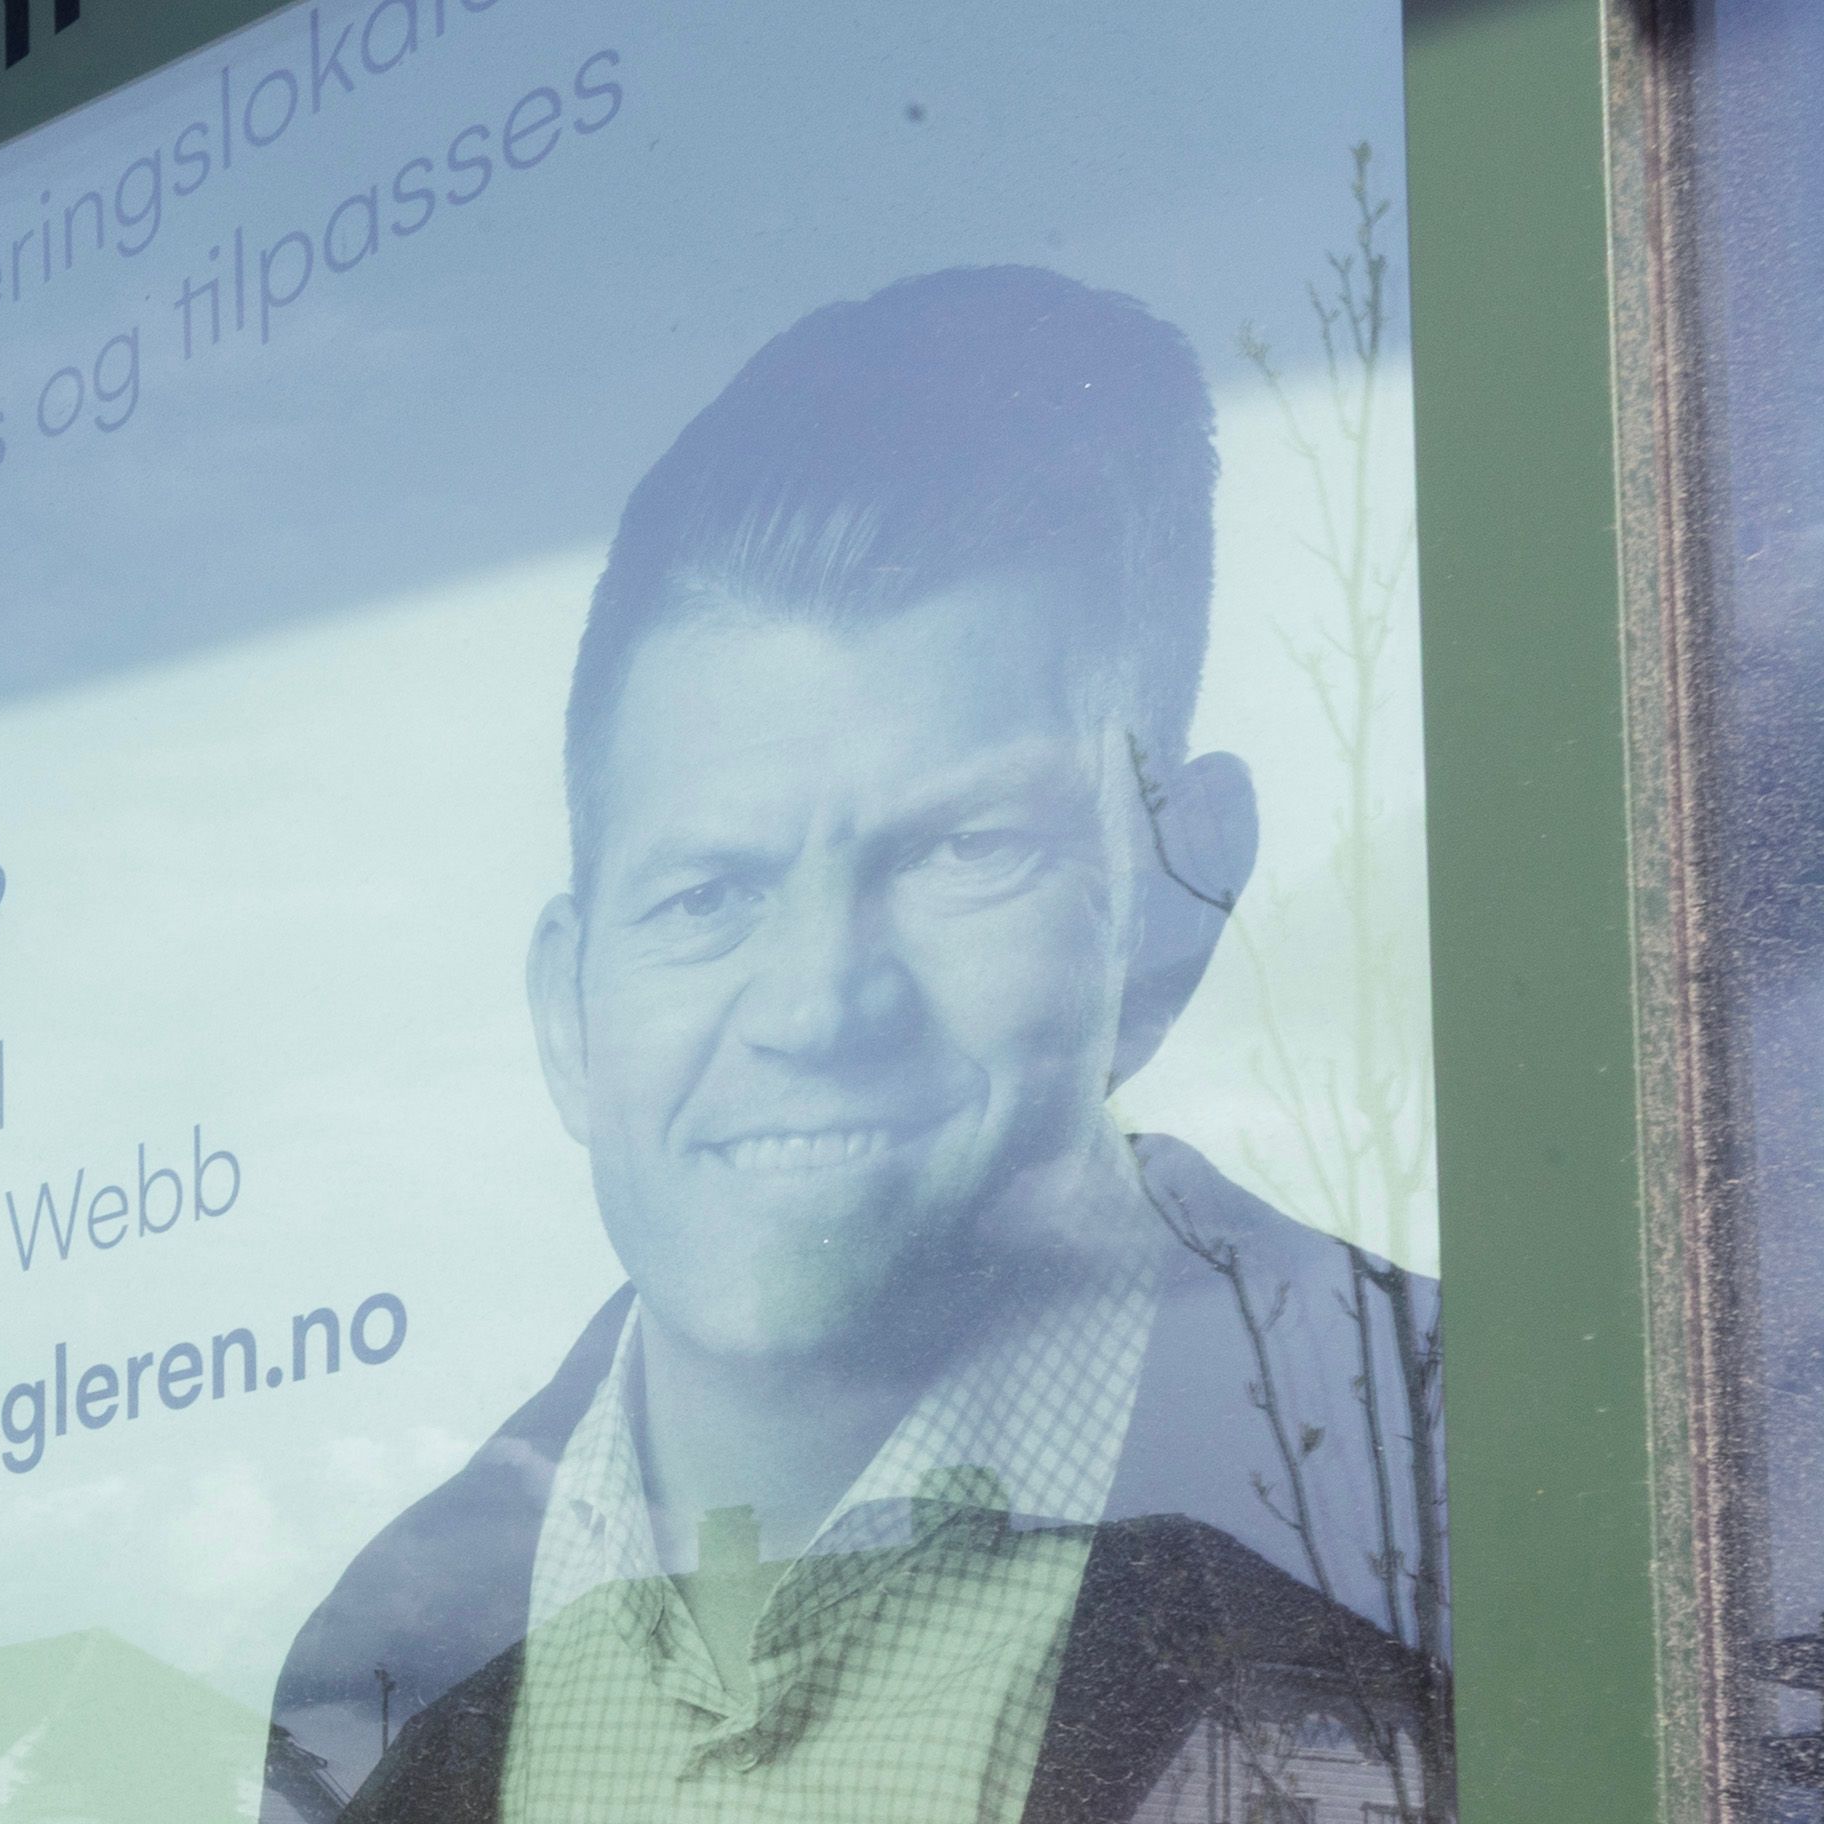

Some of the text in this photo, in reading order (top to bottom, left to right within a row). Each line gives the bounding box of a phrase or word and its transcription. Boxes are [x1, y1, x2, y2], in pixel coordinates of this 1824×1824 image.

[37, 325, 141, 434] og
[174, 48, 623, 360] tilpasses
[5, 1123, 241, 1272] Webb
